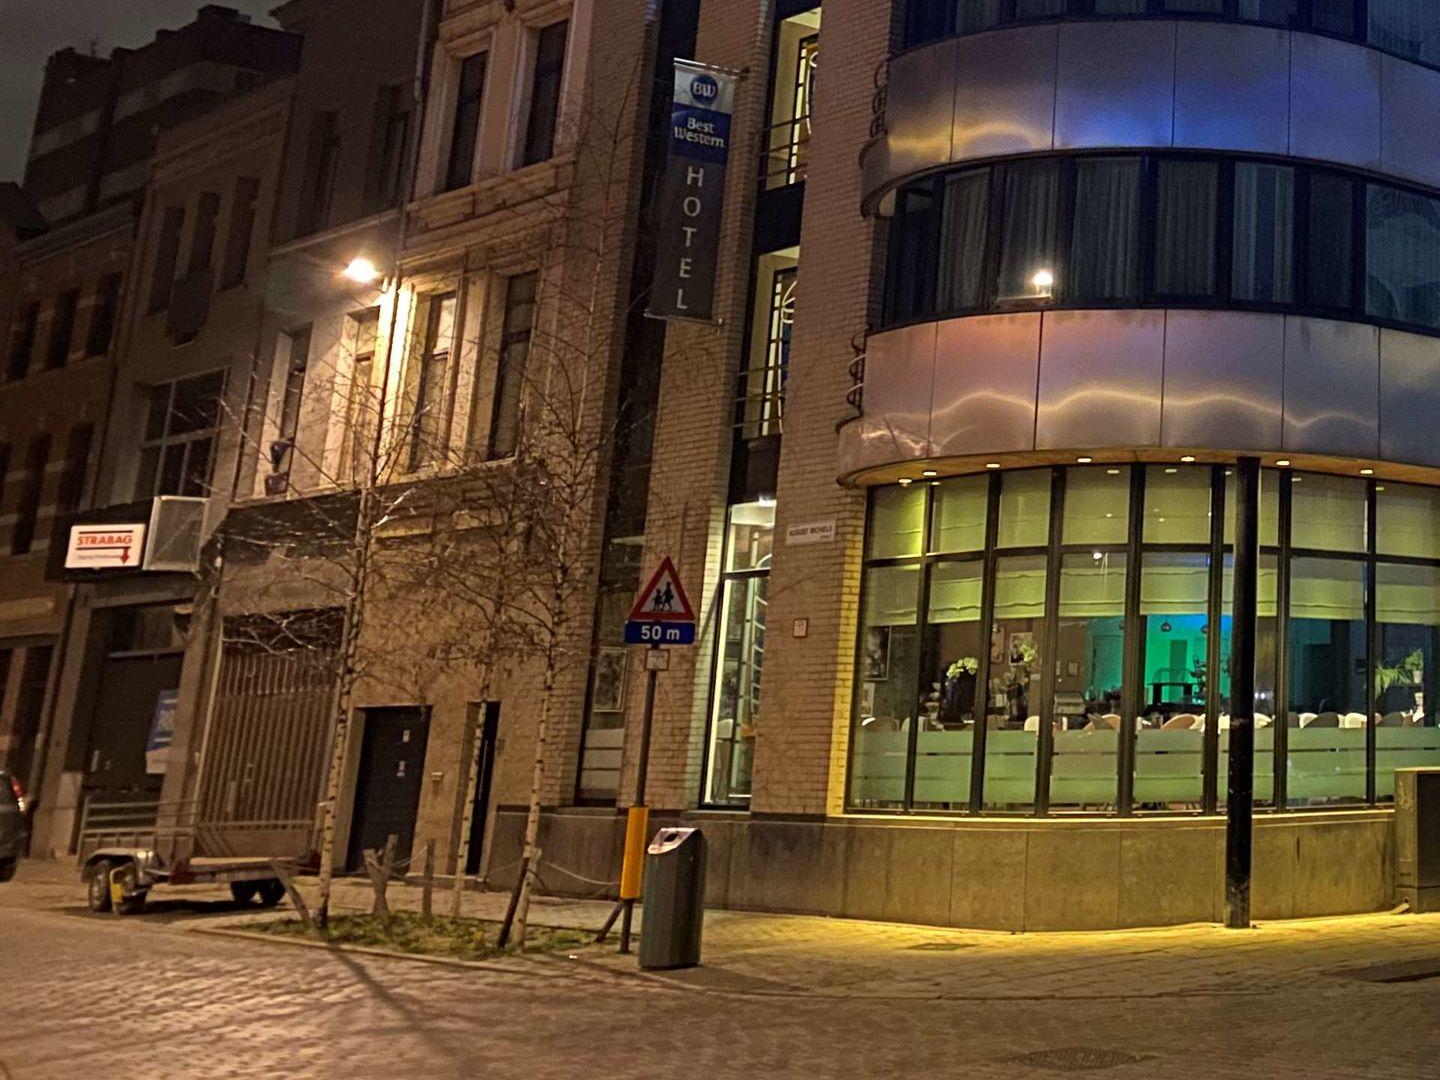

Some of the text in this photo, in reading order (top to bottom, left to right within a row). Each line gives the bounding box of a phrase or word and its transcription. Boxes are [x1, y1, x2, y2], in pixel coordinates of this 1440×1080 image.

[692, 81, 717, 98] BW
[687, 117, 714, 134] Best
[674, 126, 725, 148] Western
[676, 165, 704, 310] HOTEL
[77, 535, 132, 546] STRABAG
[641, 625, 680, 640] 50 m
